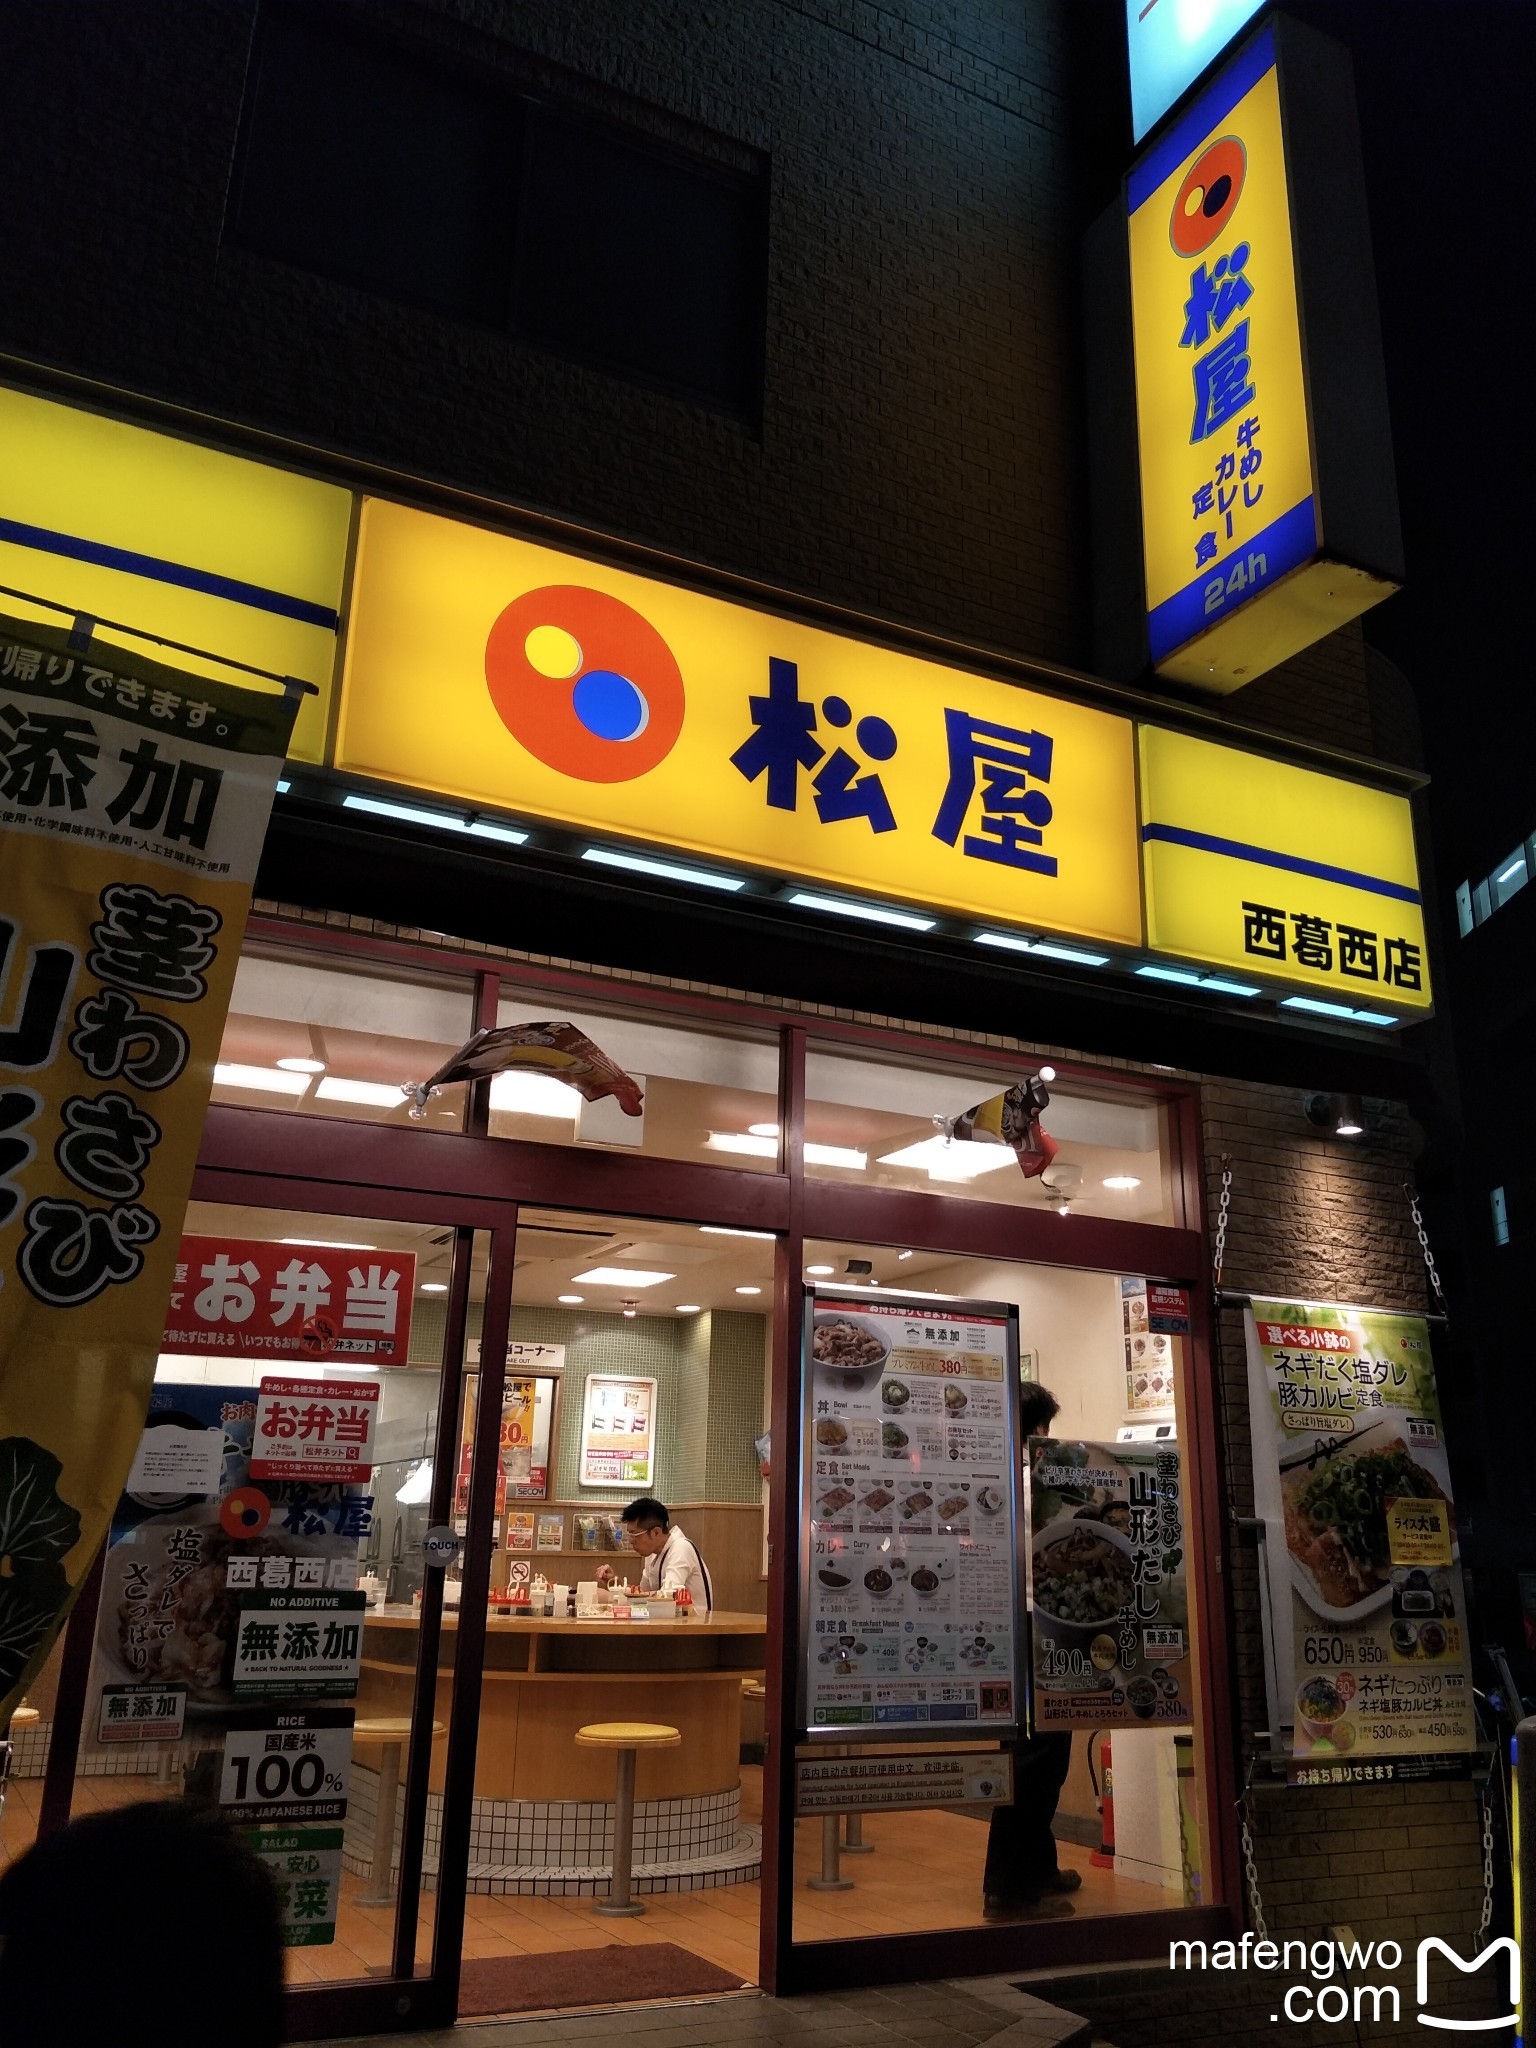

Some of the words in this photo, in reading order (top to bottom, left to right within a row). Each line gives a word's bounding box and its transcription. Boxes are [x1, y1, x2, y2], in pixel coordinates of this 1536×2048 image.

[1178, 241, 1257, 445] 松屋
[1236, 417, 1263, 509] 牛めし
[1214, 453, 1238, 539] カレー
[1191, 481, 1218, 570] 定食
[1204, 552, 1267, 616] 24h
[0, 646, 229, 737] 帰りできます。
[729, 656, 1059, 877] 松屋
[1242, 901, 1422, 991] 西葛西店
[17, 883, 225, 1307] 茎わさび
[194, 1254, 400, 1334] お弁当
[925, 1327, 960, 1342] 無添加
[1267, 1325, 1351, 1349] 選べる小鉢の
[939, 1359, 968, 1375] 380円
[1273, 1350, 1408, 1386] ネギだく塩ダレ
[817, 1399, 829, 1414] 丼
[833, 1401, 848, 1409] Bowl
[1278, 1381, 1385, 1411] 豚カルビ定食
[261, 1401, 370, 1443] お弁当
[1410, 1424, 1435, 1436] 無添加
[816, 1461, 839, 1476] 定食
[1156, 1452, 1181, 1547] 茎わさび
[281, 1495, 375, 1537] 松屋
[1394, 1515, 1442, 1533] ライス大盛
[424, 1542, 458, 1551] TOUCH
[816, 1539, 849, 1555] カレー
[853, 1541, 870, 1550] Curry
[1129, 1472, 1161, 1620] 山形だし
[152, 1528, 203, 1639] 塩ダレで
[226, 1555, 358, 1589] 西葛西店
[270, 1598, 286, 1607] NO
[289, 1597, 339, 1607] ADDITIVE
[123, 1562, 149, 1670] さっぱり
[816, 1620, 847, 1634] 朝定食
[240, 1621, 359, 1661] 無添加
[1117, 1606, 1138, 1671] 牛めし
[1146, 1630, 1179, 1645] 無添加
[1358, 1674, 1442, 1697] ネギたっぷり
[108, 1695, 177, 1718] 無添加
[1359, 1697, 1443, 1714] ネギ塩豚カルビ丼
[277, 1716, 306, 1727] RICE
[265, 1733, 317, 1752] 国産米
[231, 1754, 343, 1799] 100%
[1296, 1764, 1394, 1785] お持ち帰りできます
[256, 1805, 314, 1817] JAPANESE
[315, 1804, 340, 1815] RICE
[260, 1837, 299, 1849] SALAD
[287, 1855, 320, 1874] 安心
